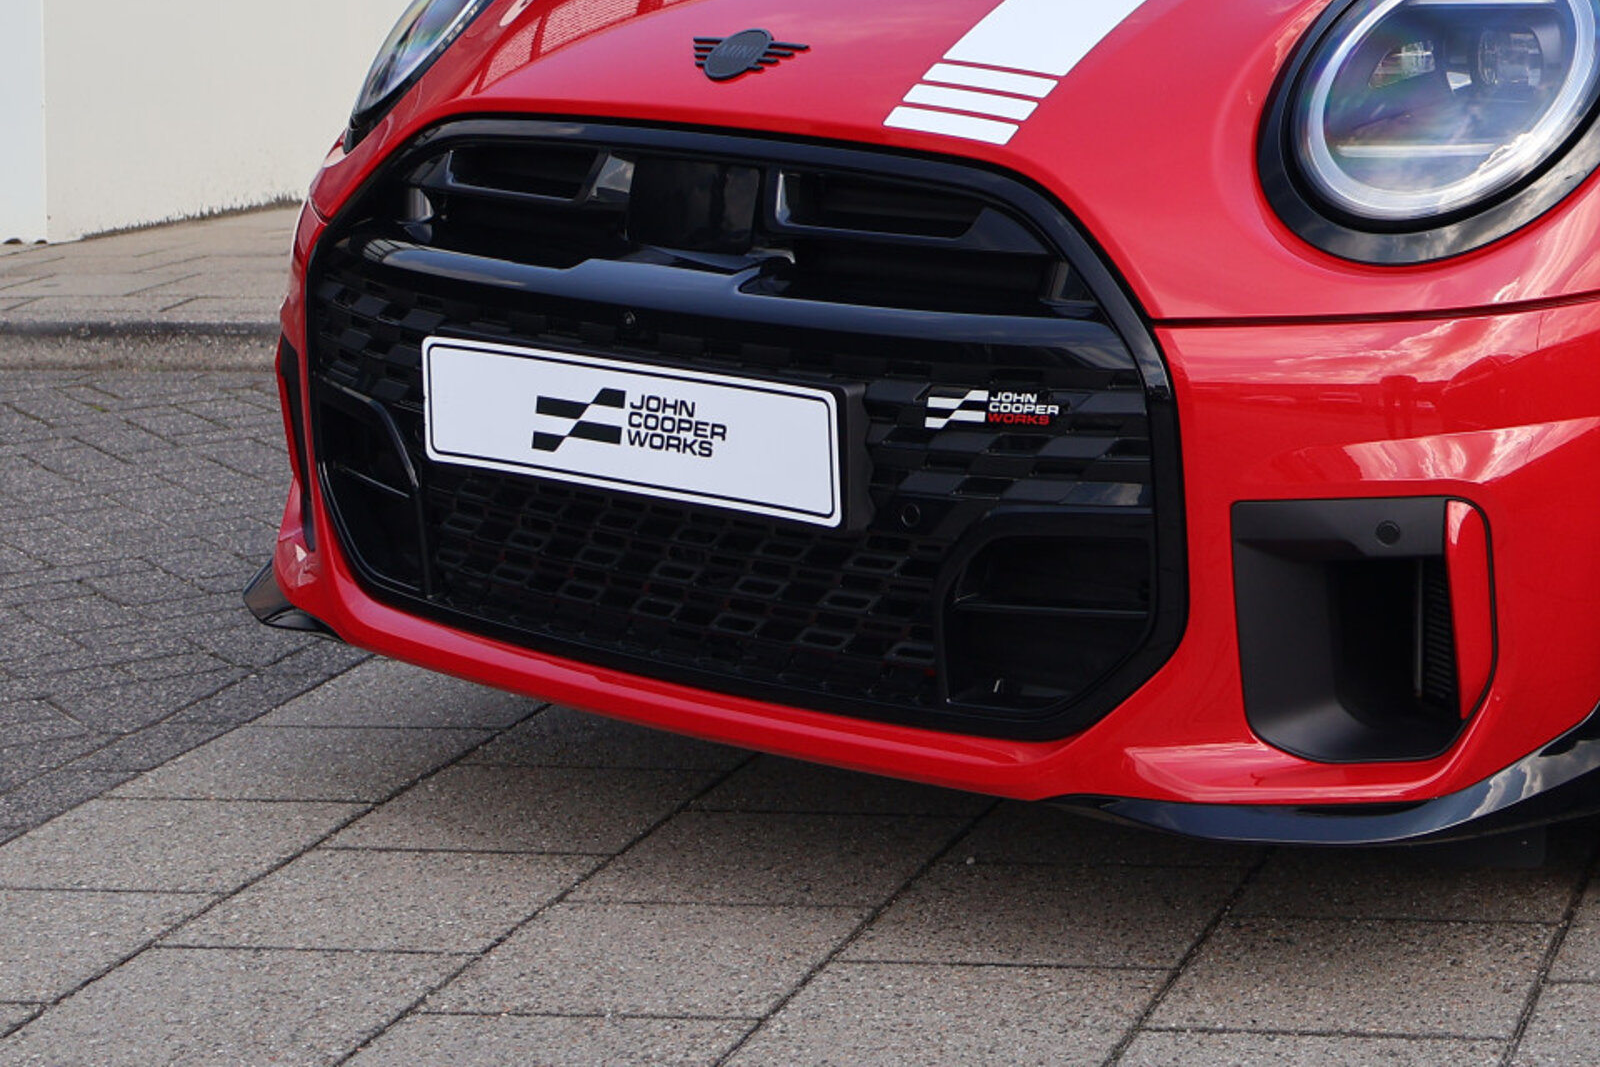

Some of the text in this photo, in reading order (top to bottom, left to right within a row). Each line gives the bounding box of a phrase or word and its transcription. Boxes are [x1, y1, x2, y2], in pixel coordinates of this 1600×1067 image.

[629, 394, 696, 418] JOHN
[989, 391, 1038, 403] JOHN
[988, 402, 1060, 415] COOPER
[627, 411, 728, 442] COOPER
[987, 412, 1050, 425] WORKS
[627, 429, 714, 458] WORKS
